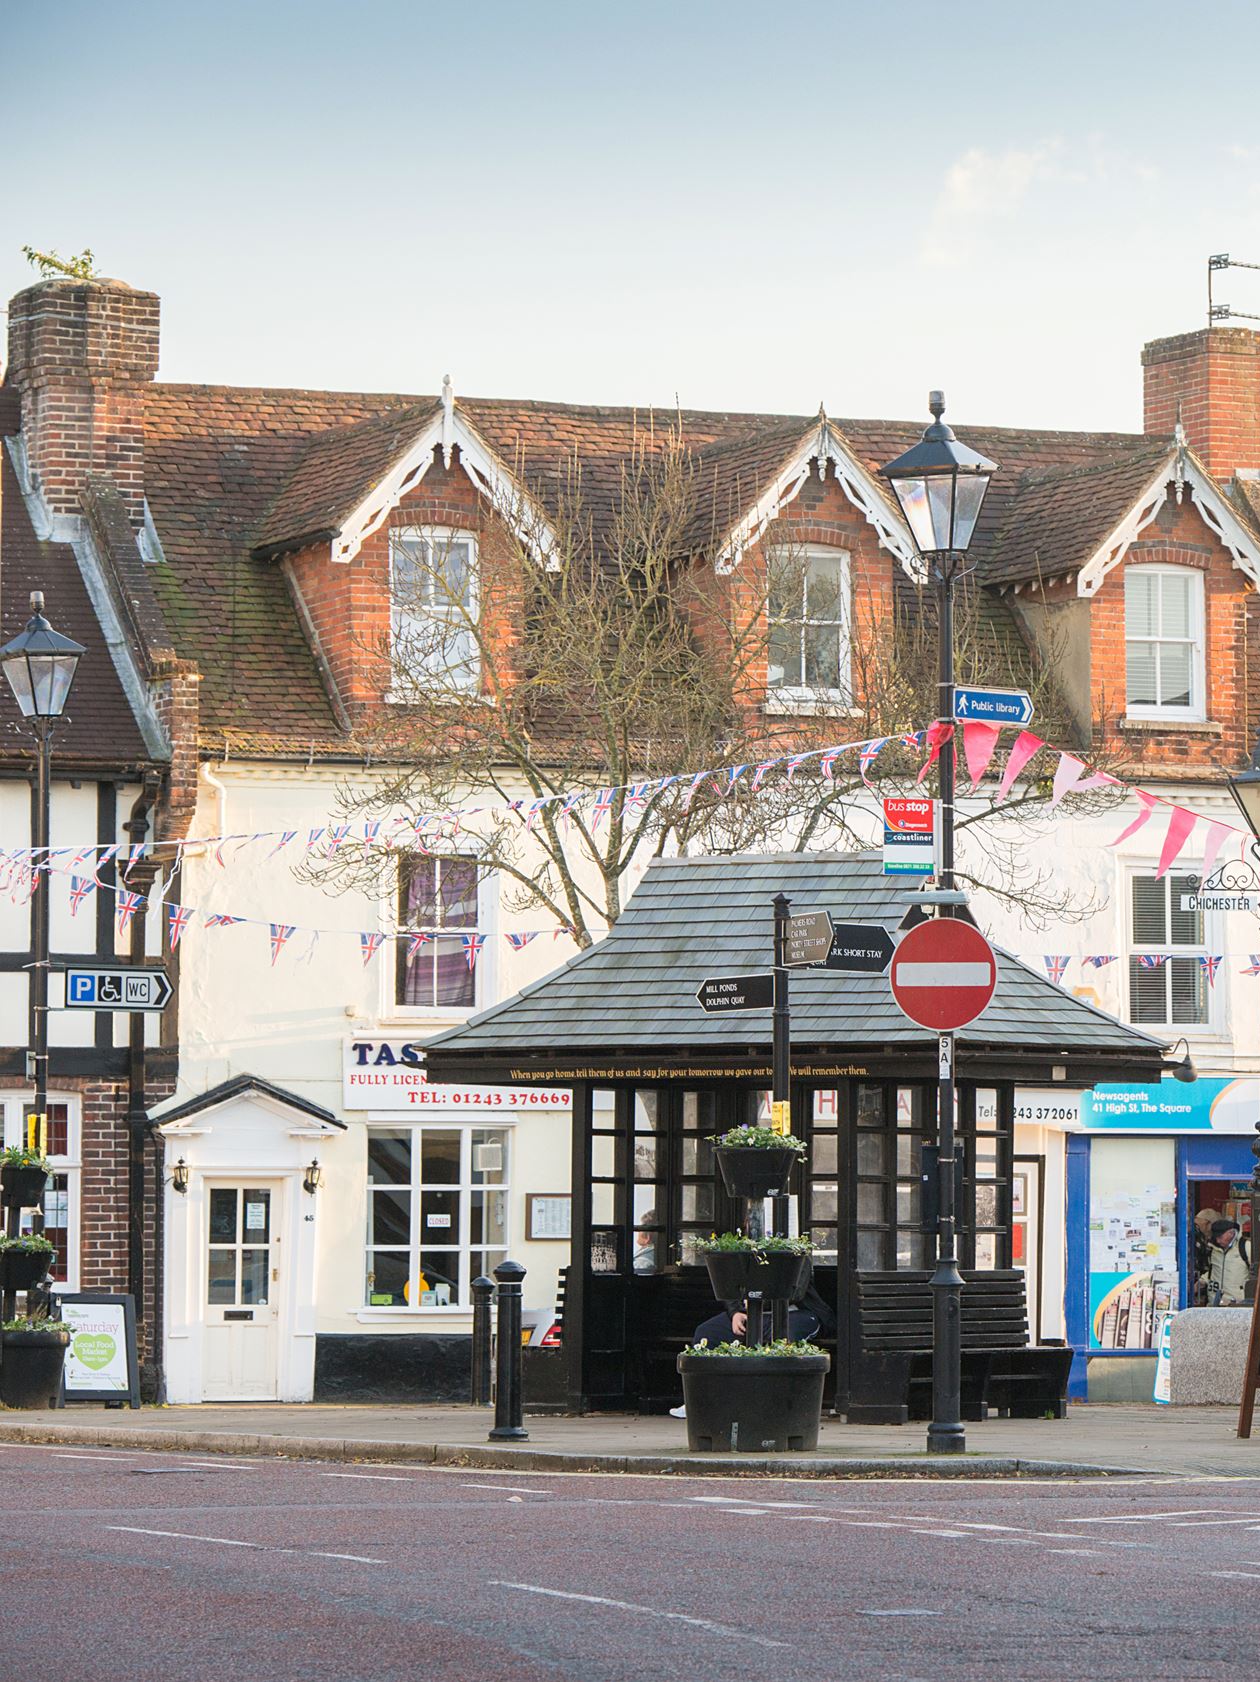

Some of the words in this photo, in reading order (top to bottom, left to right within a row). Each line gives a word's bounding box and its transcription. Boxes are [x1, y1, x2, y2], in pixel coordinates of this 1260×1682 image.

[971, 699, 994, 711] Public
[887, 800, 905, 811] bus
[906, 802, 929, 815] stop
[893, 833, 932, 841] coastliner
[1188, 896, 1250, 910] CHICHESTER
[844, 948, 865, 958] SHORT
[867, 950, 883, 959] STAY
[76, 977, 92, 999] P
[129, 982, 147, 997] WC
[706, 985, 718, 993] MILL
[720, 983, 738, 992] PONDS
[706, 997, 729, 1006] DOLPHIN
[731, 996, 745, 1005] QUAY
[941, 1037, 949, 1048] 5
[940, 1052, 949, 1063] A
[510, 1069, 531, 1079] When
[532, 1071, 545, 1080] you
[545, 1071, 555, 1080] go
[588, 1067, 606, 1077] them
[607, 1067, 614, 1078] of
[615, 1069, 624, 1077] us
[625, 1067, 641, 1077] and
[642, 1069, 657, 1079] say
[656, 1067, 669, 1078] for
[669, 1069, 687, 1078] your
[688, 1067, 723, 1076] tomorrow
[735, 1068, 752, 1078] gave
[753, 1068, 765, 1076] our
[798, 1065, 811, 1075] will
[812, 1064, 849, 1075] remember
[350, 1074, 389, 1085] FULLY
[408, 1092, 447, 1104] TEL:
[452, 1092, 502, 1106] 01243
[509, 1091, 571, 1106] 376669
[1092, 1091, 1149, 1102] Newsagents
[1012, 1107, 1033, 1119] 243
[1036, 1107, 1078, 1120] 372061
[1092, 1103, 1103, 1112] 41
[1106, 1103, 1127, 1114] High
[1141, 1103, 1158, 1112] The
[1159, 1103, 1192, 1115] Square
[429, 1217, 449, 1225] CLOSED
